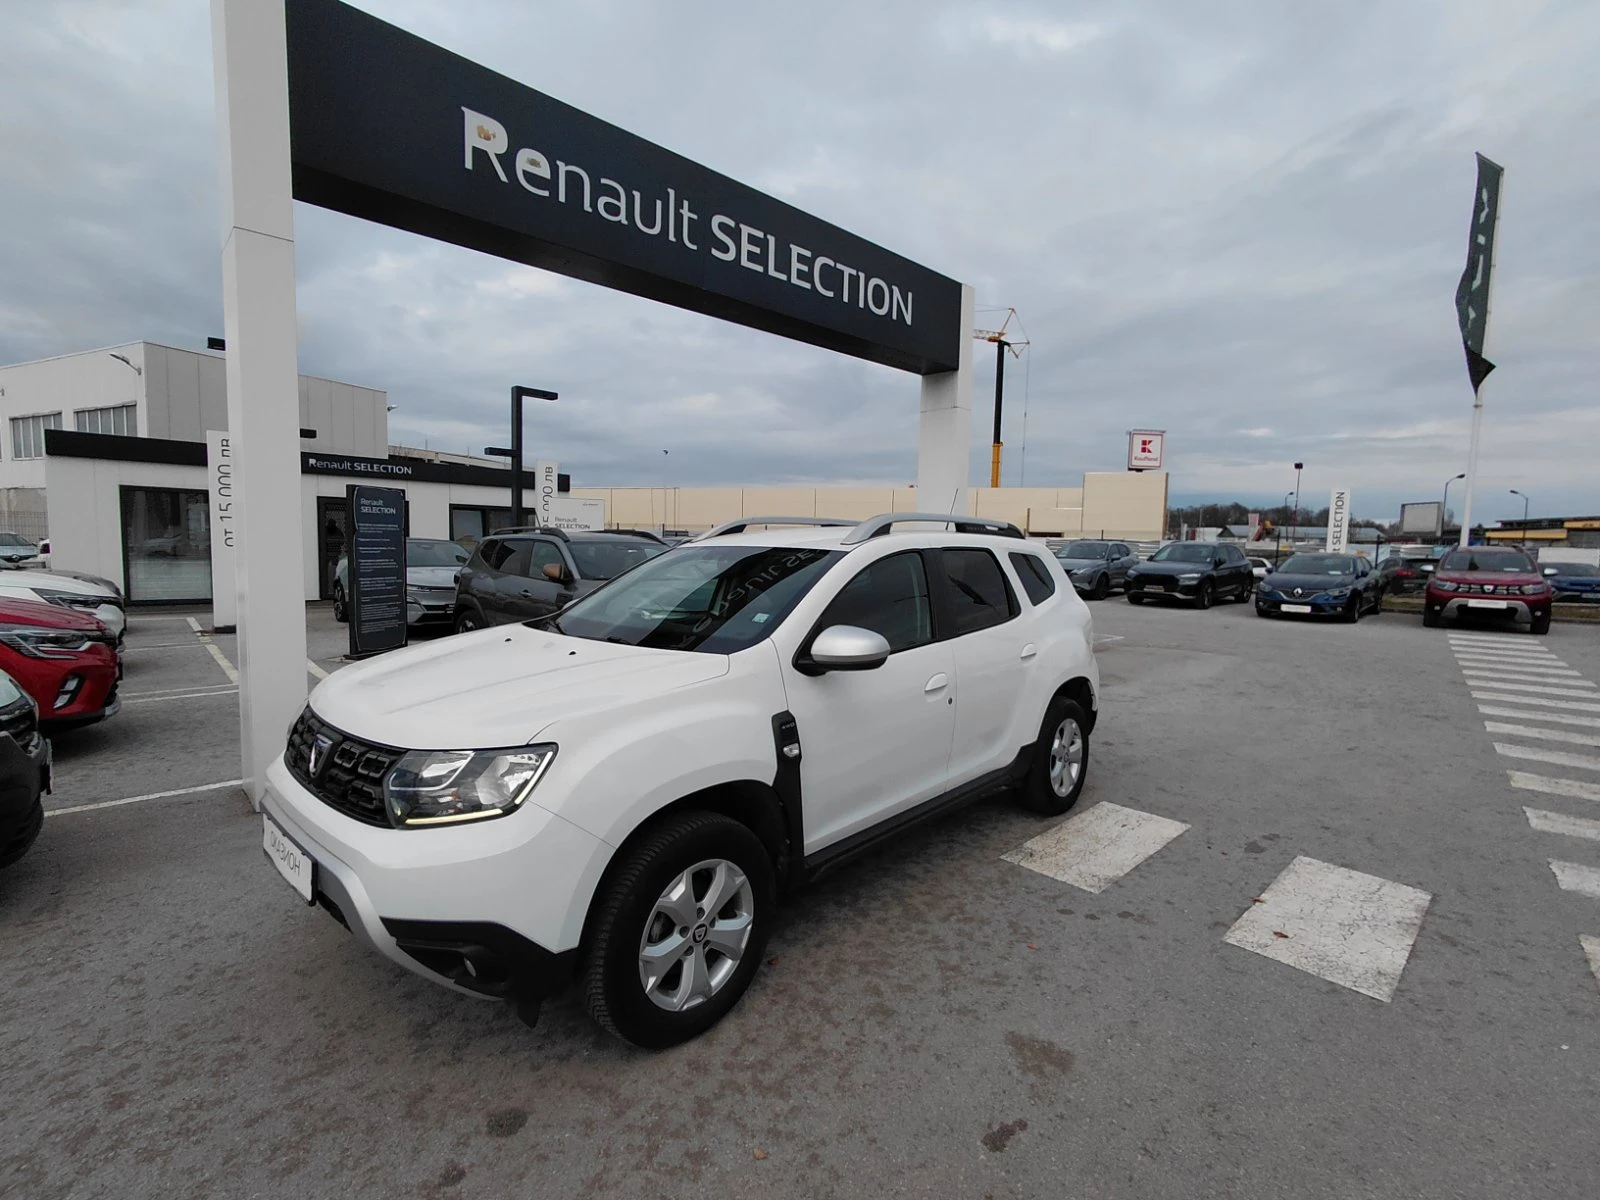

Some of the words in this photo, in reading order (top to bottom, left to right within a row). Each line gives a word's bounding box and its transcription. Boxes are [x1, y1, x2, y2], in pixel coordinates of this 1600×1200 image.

[461, 106, 698, 251] Renault
[711, 214, 913, 326] SELECTION
[308, 458, 352, 471] Renault
[353, 462, 413, 475] SELECTION
[360, 497, 384, 506] Renault
[219, 503, 232, 521] 15
[360, 506, 396, 515] SELECTION
[1332, 491, 1345, 545] SELECTION
